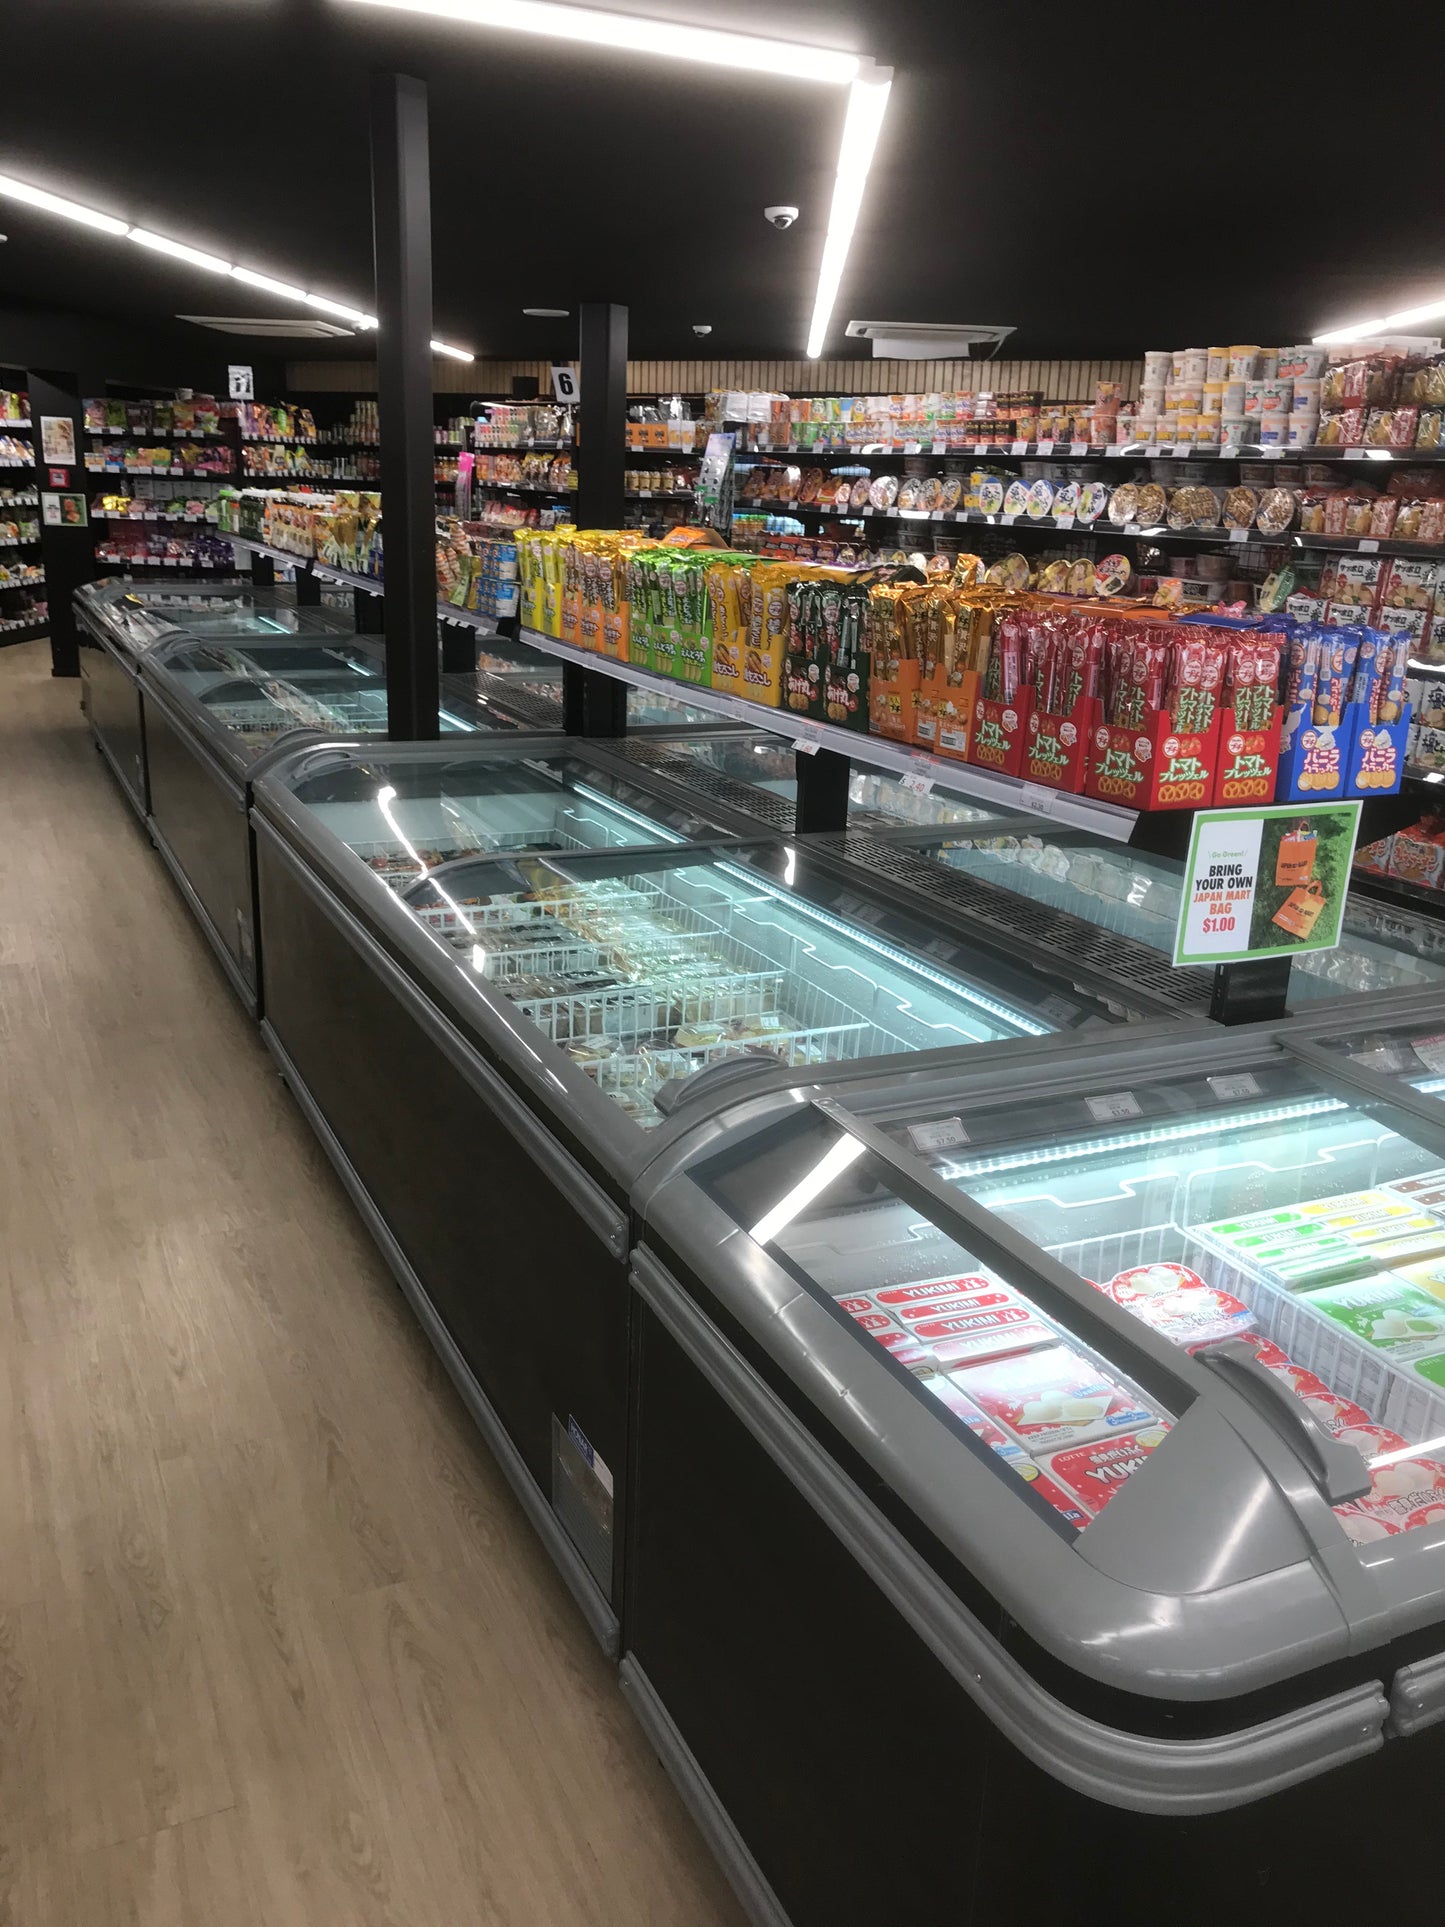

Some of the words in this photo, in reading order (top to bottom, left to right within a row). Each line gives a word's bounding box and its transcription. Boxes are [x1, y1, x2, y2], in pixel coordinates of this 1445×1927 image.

[558, 373, 574, 395] 6
[982, 720, 1004, 738] トマト
[1036, 733, 1062, 752] トマト
[1106, 748, 1136, 769] トマト
[1235, 754, 1265, 769] トマト
[1304, 749, 1340, 764] バニラ
[1362, 748, 1396, 763] バニラ
[1095, 762, 1144, 782] プレッツェル
[1170, 757, 1202, 773] トマト
[1304, 764, 1339, 773] クラッカー
[1362, 762, 1395, 772] クラッカー
[1158, 770, 1210, 783] プレッツェル
[1224, 766, 1272, 780] プレッツェル
[1209, 864, 1242, 877] BRING
[1196, 878, 1224, 891] YOUR
[1227, 876, 1253, 889] OWN
[1194, 892, 1222, 903] JAPAN
[1226, 890, 1252, 901] MART
[1209, 902, 1232, 915] BAG
[1202, 916, 1236, 934] $1.00
[902, 1282, 961, 1298] YUKIMI
[930, 1298, 982, 1313] YUKIMI
[941, 1314, 999, 1332] YUKIMI
[1058, 1452, 1084, 1463] LOTTE
